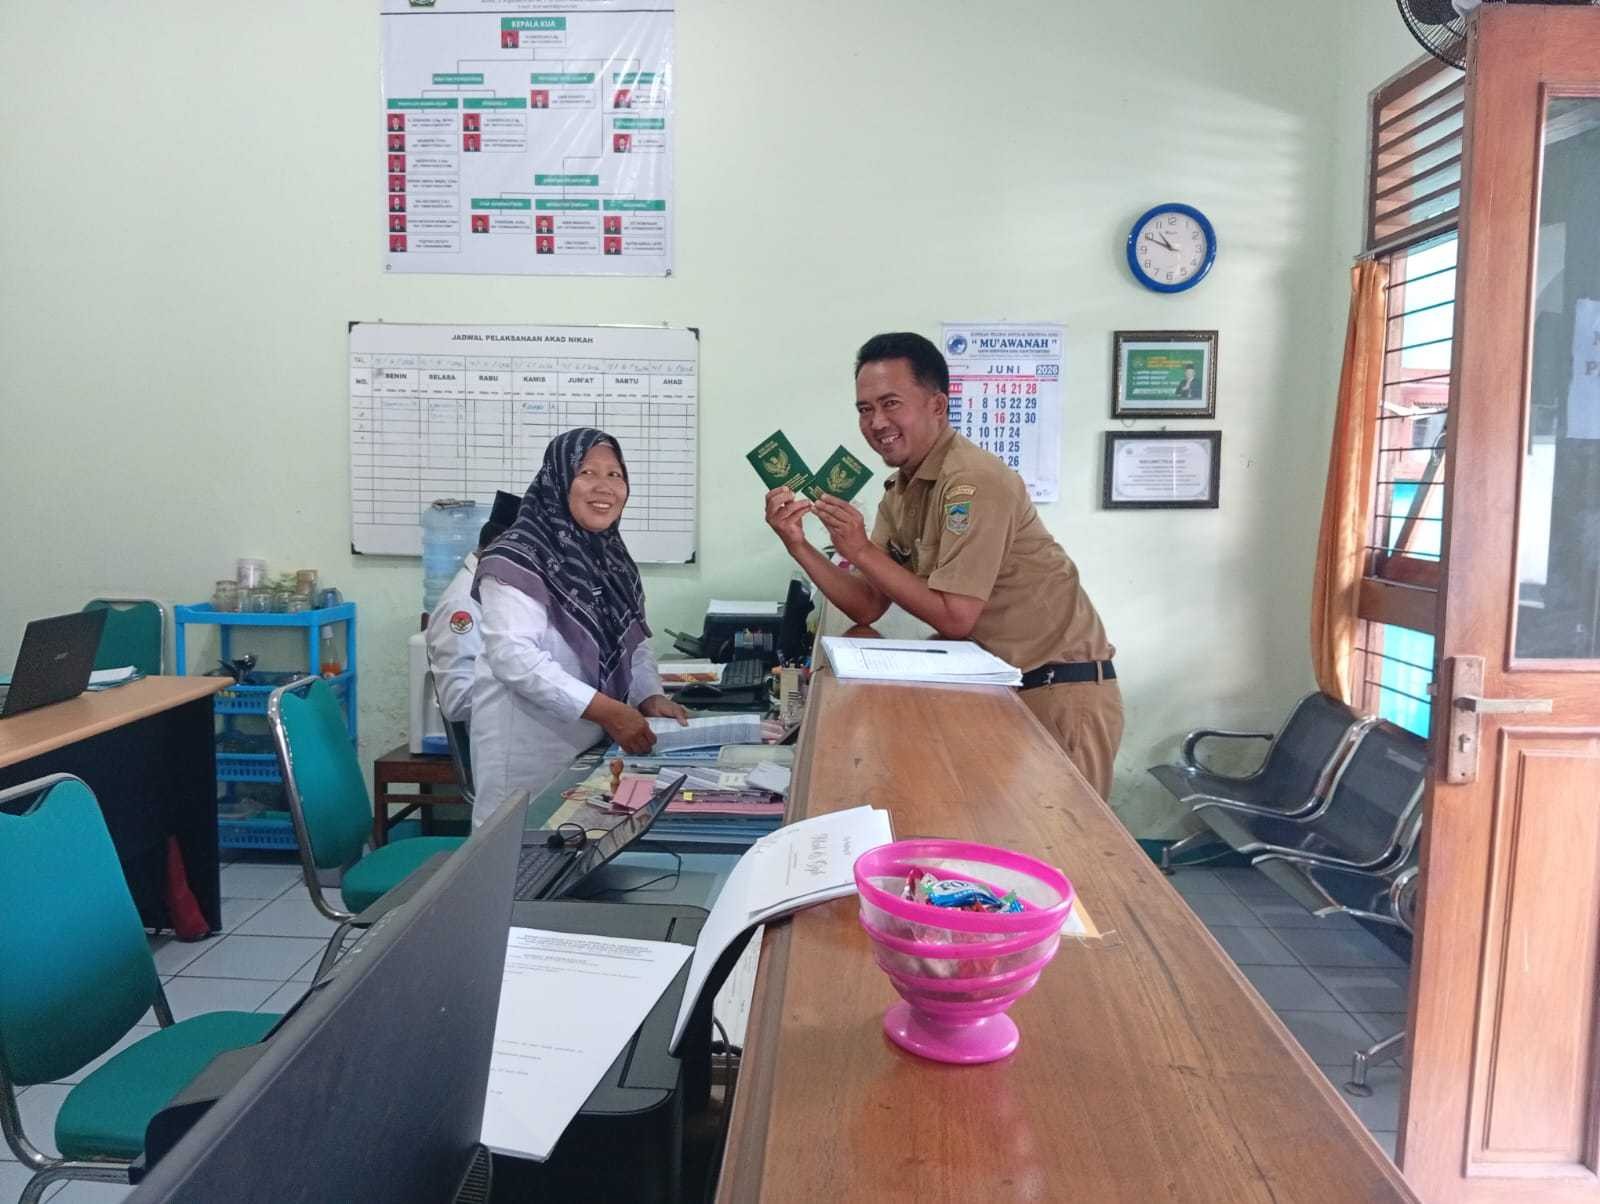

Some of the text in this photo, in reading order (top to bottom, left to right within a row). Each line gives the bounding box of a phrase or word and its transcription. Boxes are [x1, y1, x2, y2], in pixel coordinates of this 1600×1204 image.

[511, 20, 539, 28] KEPALA
[1156, 221, 1162, 229] 11
[1168, 217, 1176, 225] 12
[1192, 231, 1199, 240] 2
[1140, 246, 1147, 254] 9
[1195, 245, 1201, 253] 3
[1144, 259, 1151, 268] 8
[1153, 268, 1159, 276] 7
[1166, 272, 1173, 280] 6
[1180, 267, 1187, 276] 5
[451, 334, 483, 342] JADWAL
[485, 335, 542, 343] PELAKSANAAN
[568, 336, 594, 344] NIKAH
[979, 338, 1049, 349] MU'AWANAH
[987, 364, 1020, 375] JUNI
[983, 384, 1037, 394] 7 14 21 28
[968, 398, 1037, 409] 1 8 15 22 29
[966, 412, 1036, 424] 2 9 16 23 30
[966, 427, 1020, 438] 3 10 17 24
[979, 441, 1020, 452] 11 18 25
[1008, 456, 1019, 467] 26
